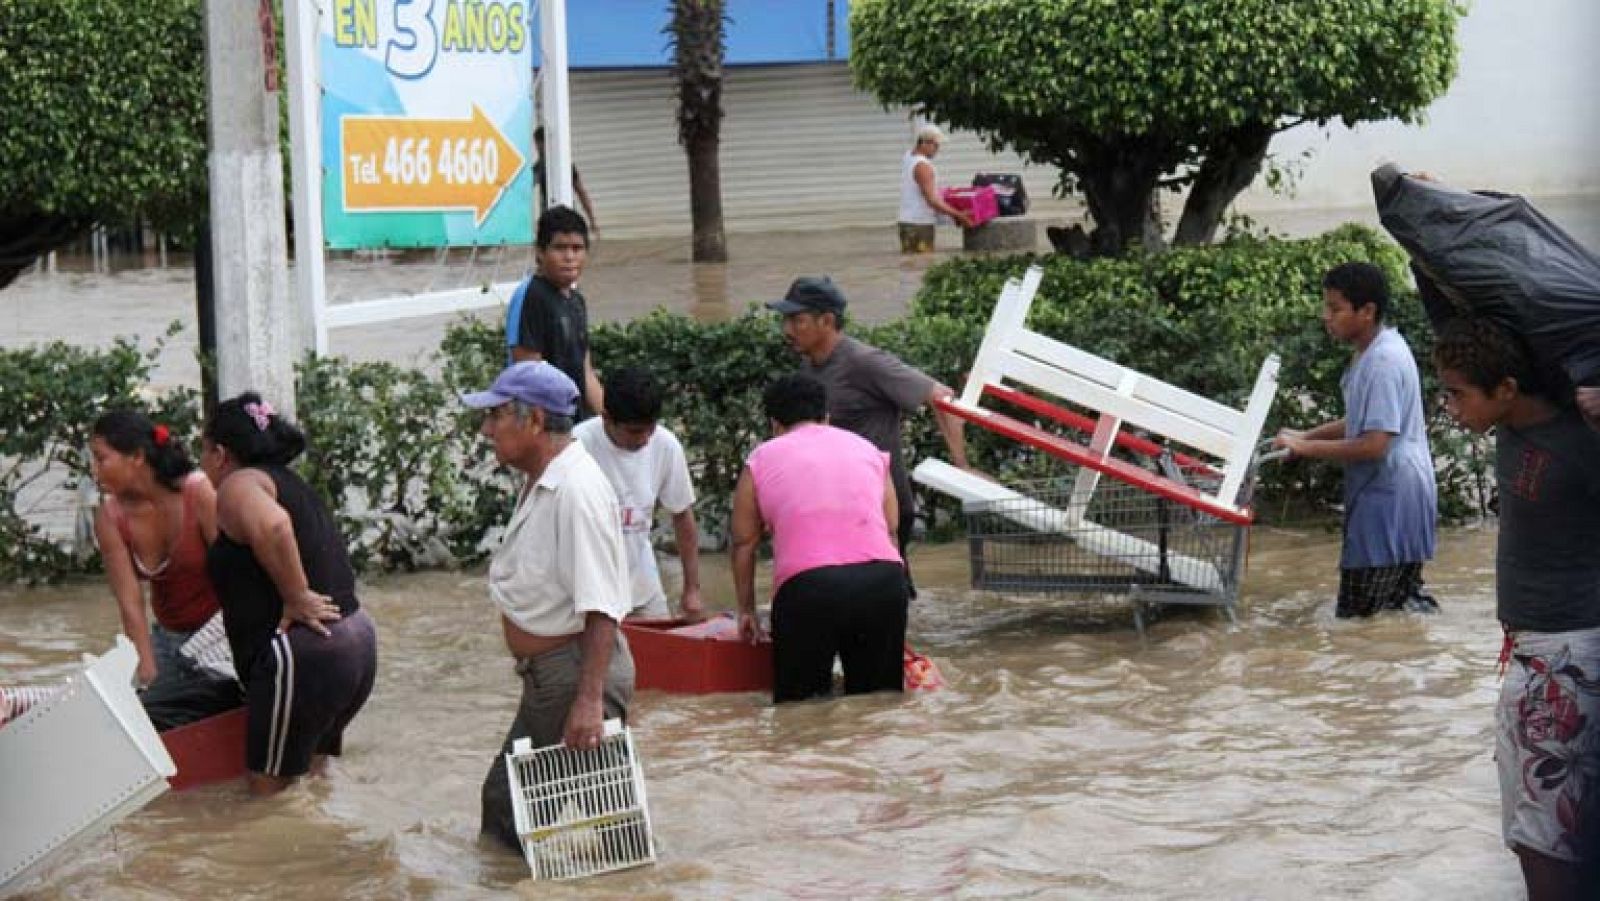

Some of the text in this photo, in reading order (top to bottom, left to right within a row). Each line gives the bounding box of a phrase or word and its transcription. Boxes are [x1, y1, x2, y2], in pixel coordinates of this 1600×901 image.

[334, 0, 378, 48] EN
[385, 0, 437, 79] 3
[442, 0, 525, 53] AÑOS
[350, 136, 498, 185] Tel. 466 4660
